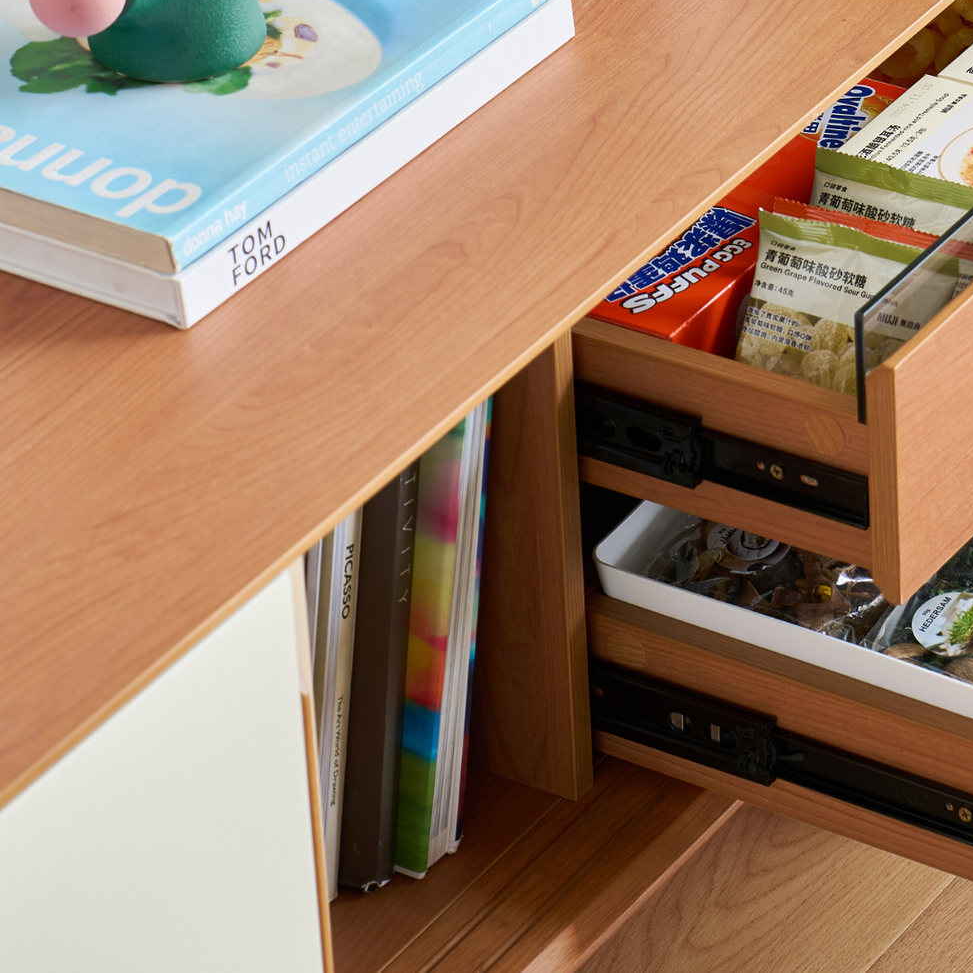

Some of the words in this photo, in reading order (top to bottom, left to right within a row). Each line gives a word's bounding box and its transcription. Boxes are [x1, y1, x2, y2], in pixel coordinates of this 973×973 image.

[818, 85, 875, 149] Ovaltine
[888, 81, 934, 118] 2024.11.15
[917, 101, 939, 117] Tremella
[934, 92, 950, 102] Soup
[283, 135, 336, 183] instant
[337, 72, 425, 143] entertaining
[824, 181, 848, 193] 口袋零食
[182, 217, 223, 257] donna
[224, 199, 248, 227] hay
[818, 191, 917, 230] 青葡萄味酸砂软糖
[228, 220, 273, 265] TOM
[232, 234, 287, 287] FORD
[713, 238, 753, 263] EGG
[770, 240, 797, 251] 口袋零食
[622, 258, 721, 314] PUFFS
[760, 262, 783, 276] Green
[784, 269, 808, 282] Grape
[808, 275, 842, 292] Flavored
[843, 286, 861, 298] Sour
[764, 249, 868, 289] 青葡萄味酸砂软糖
[877, 312, 898, 326] MUJI
[342, 543, 355, 619] PICASSO
[919, 596, 953, 633] HEDERSAM
[330, 769, 339, 807] Drawing
